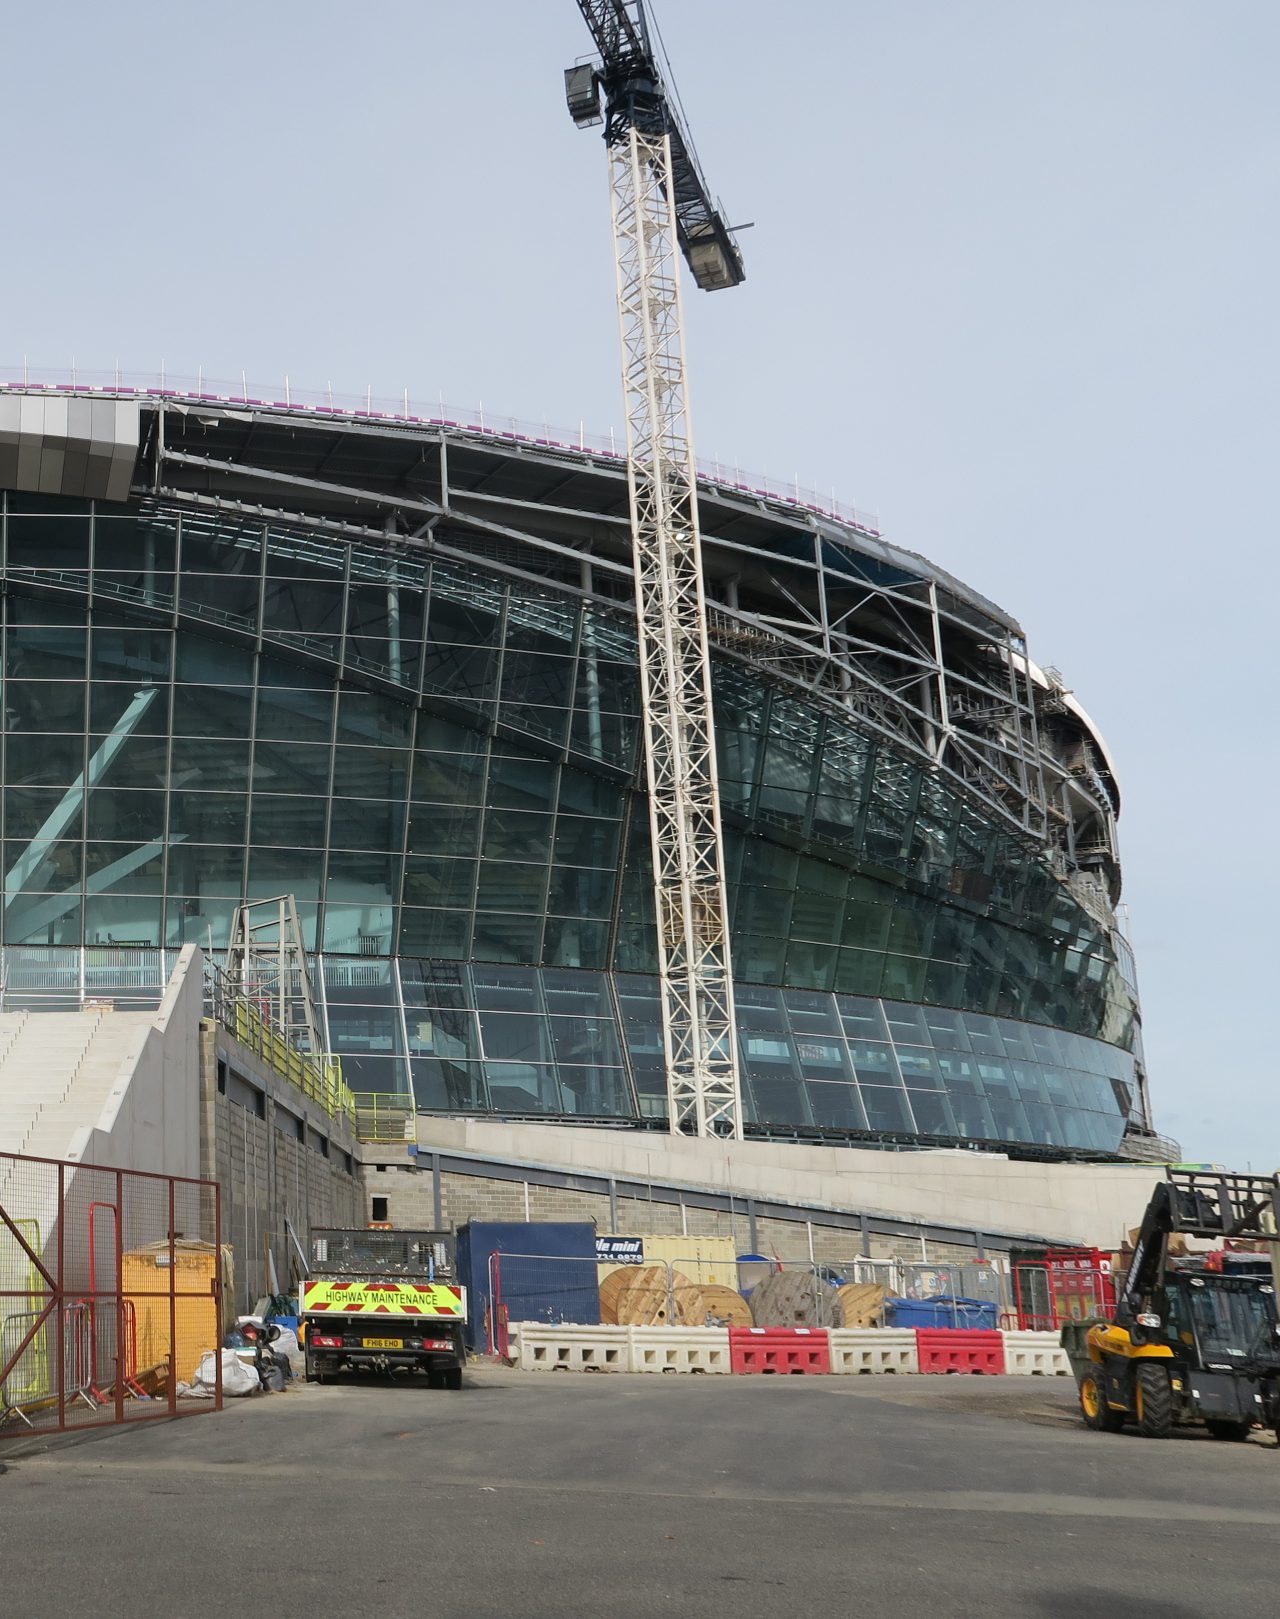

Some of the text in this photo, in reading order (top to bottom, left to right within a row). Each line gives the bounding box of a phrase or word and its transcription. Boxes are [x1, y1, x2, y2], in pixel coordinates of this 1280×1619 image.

[611, 1241, 640, 1252] mini
[325, 1291, 438, 1306] HIGHWAY MAINTENANCE
